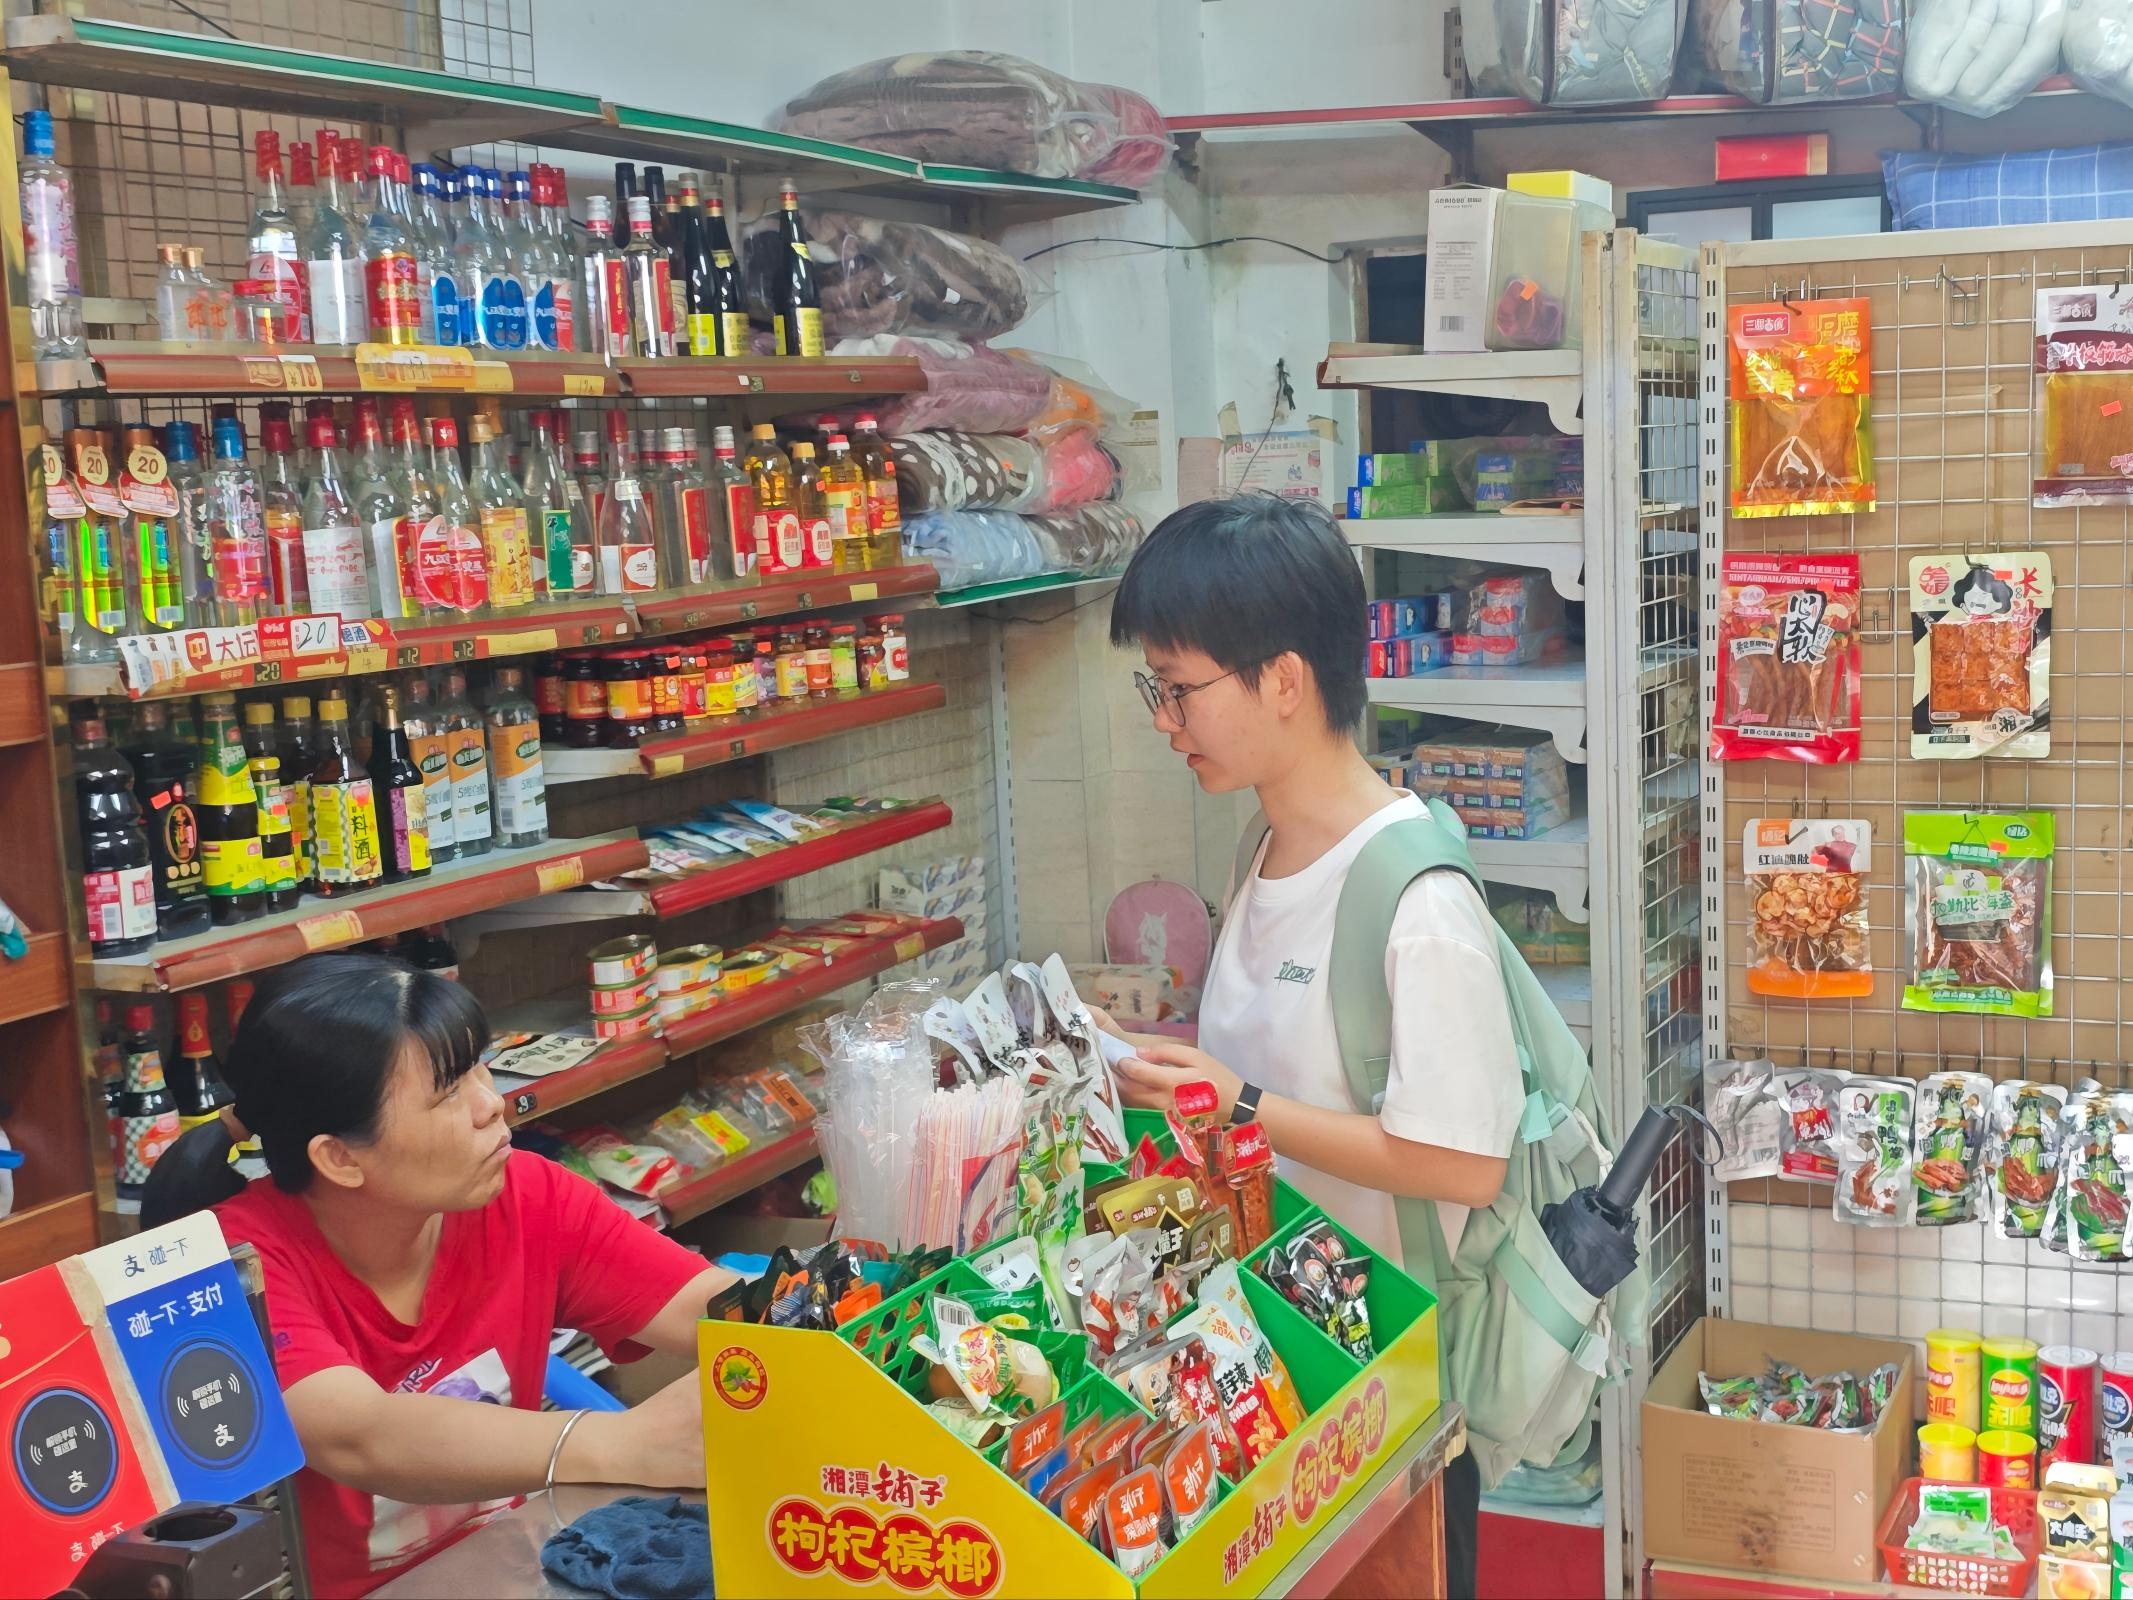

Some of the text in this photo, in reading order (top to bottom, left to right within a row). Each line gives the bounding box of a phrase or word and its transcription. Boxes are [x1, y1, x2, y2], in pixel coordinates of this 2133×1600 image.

[87, 456, 103, 475] 20
[137, 456, 159, 474] 20
[297, 620, 327, 650] 20
[149, 1237, 189, 1266] 碰一下
[1294, 1389, 1384, 1511] 枸杞槟榔
[822, 1462, 944, 1509] 湘潭铺子
[776, 1511, 993, 1588] 枸杞槟榔
[1223, 1493, 1287, 1585] 湘潭铺子
